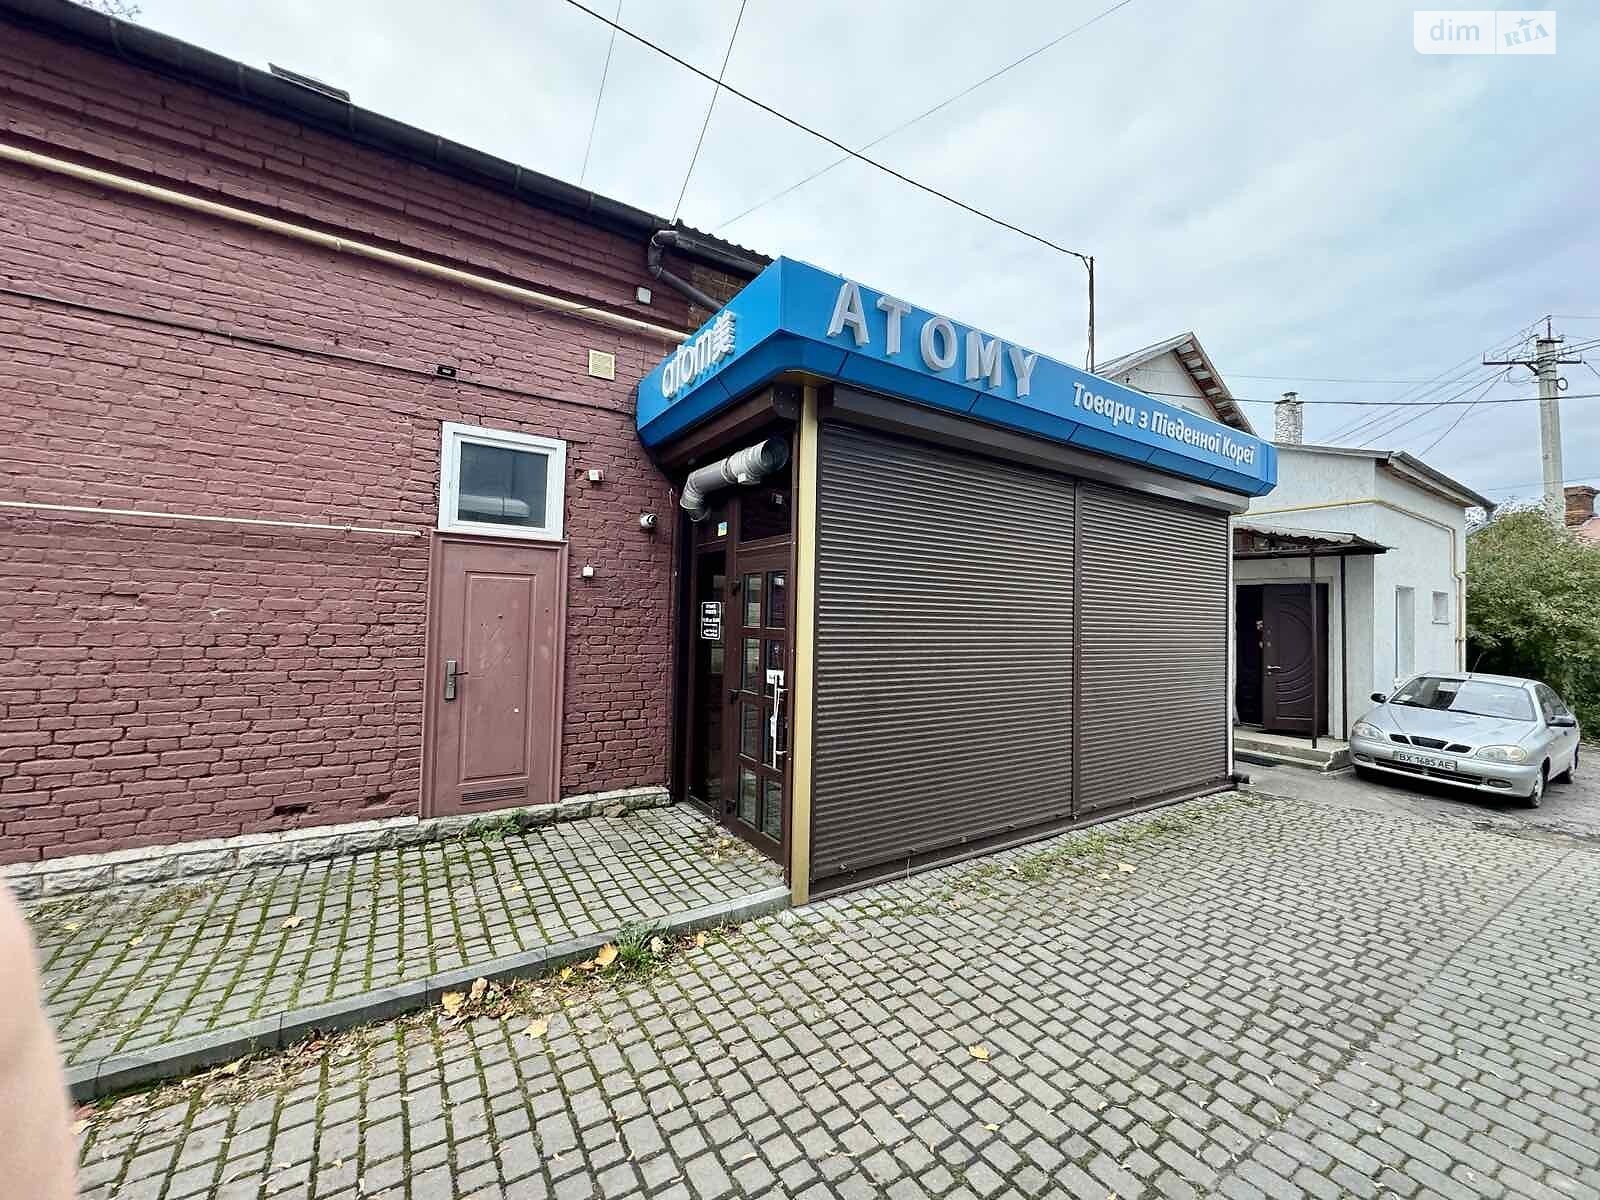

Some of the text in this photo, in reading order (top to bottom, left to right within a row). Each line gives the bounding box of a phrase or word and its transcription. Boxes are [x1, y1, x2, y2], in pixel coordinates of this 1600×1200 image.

[826, 281, 1038, 398] ATOMY
[1072, 381, 1256, 466] Товари з Південної Кореї
